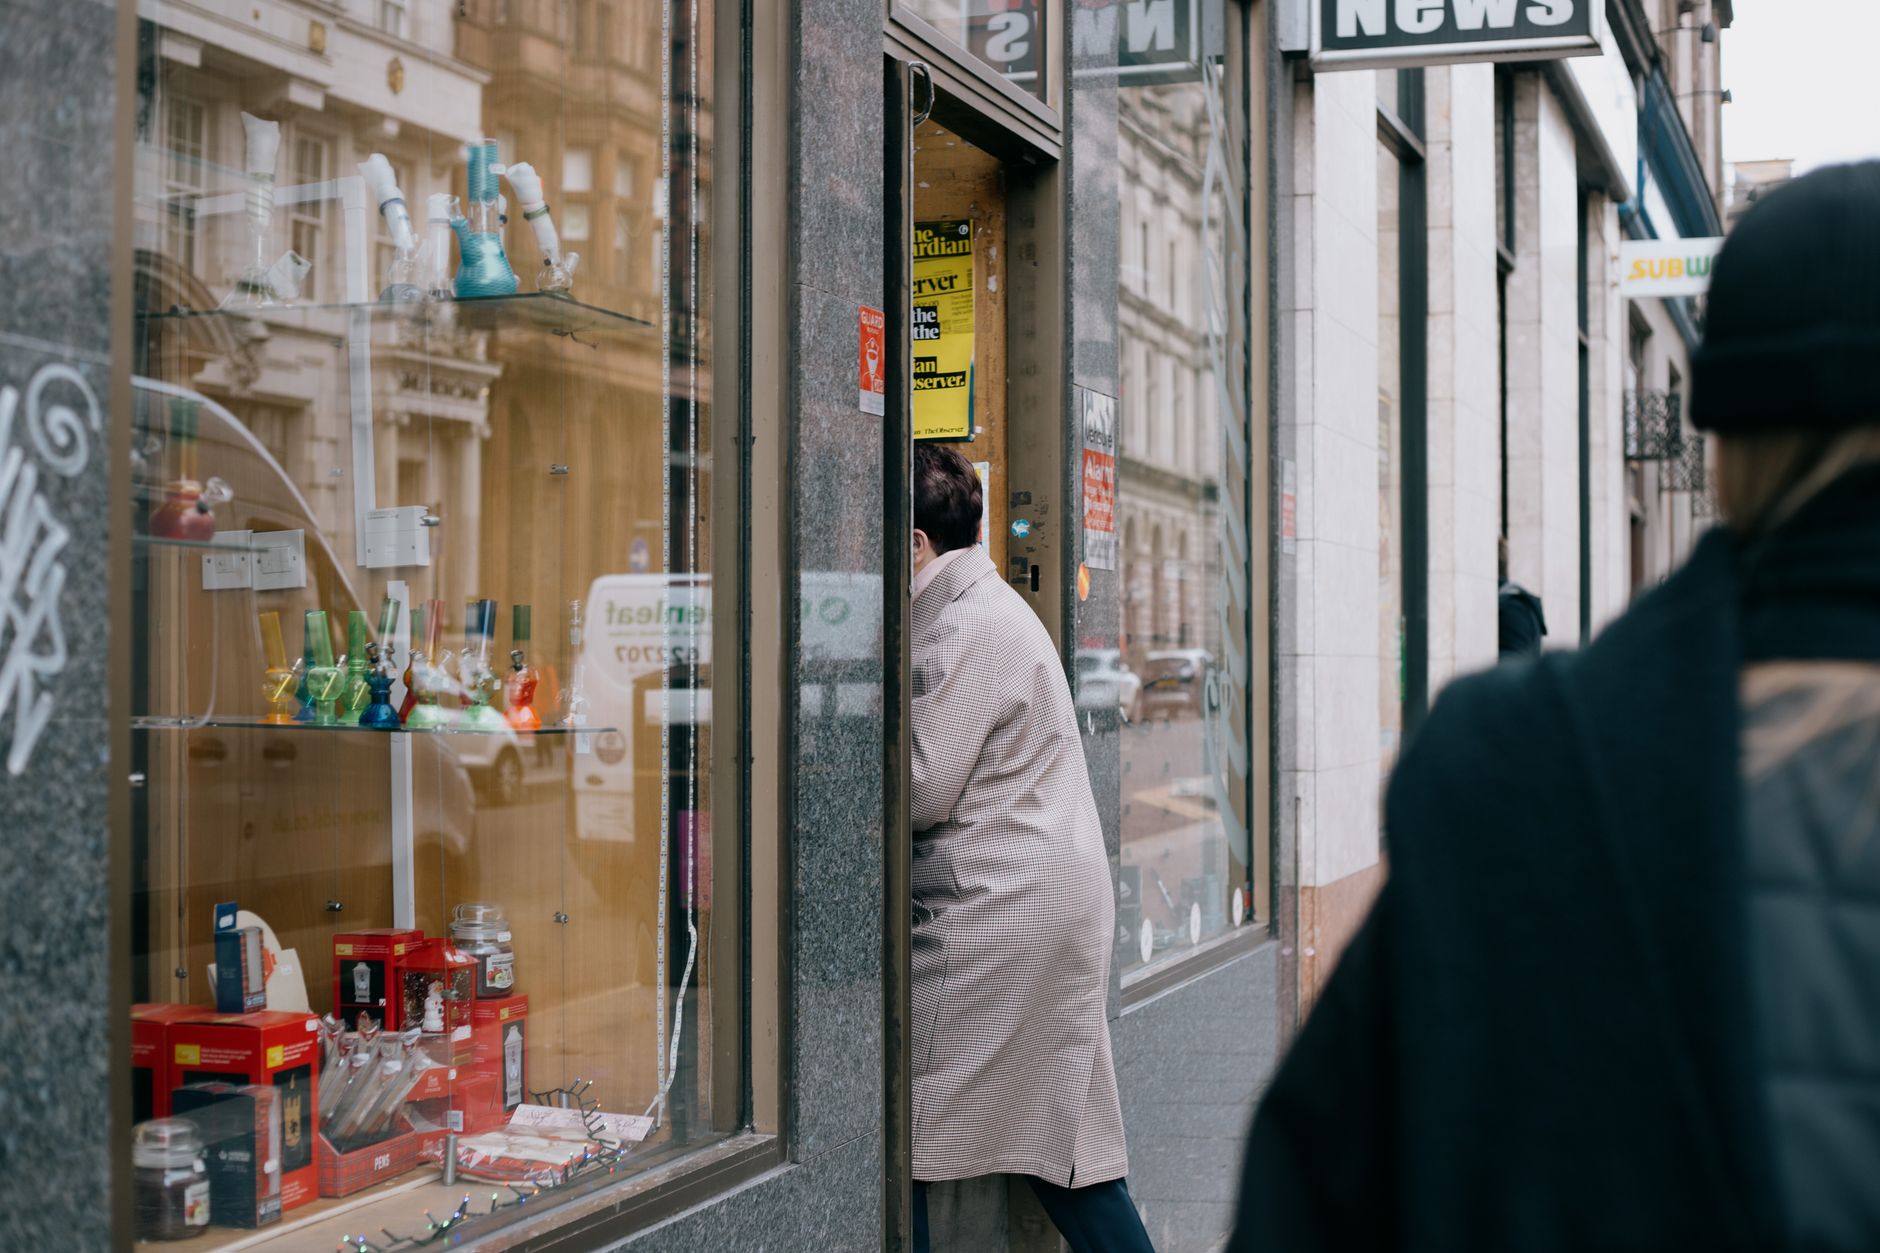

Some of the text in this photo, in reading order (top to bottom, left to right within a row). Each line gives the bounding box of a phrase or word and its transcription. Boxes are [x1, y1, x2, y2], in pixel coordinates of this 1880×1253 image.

[1337, 0, 1574, 37] News
[1628, 256, 1712, 281] SUBW
[913, 324, 939, 340] the
[1085, 456, 1112, 483] Alarm
[374, 1154, 390, 1170] PENS
